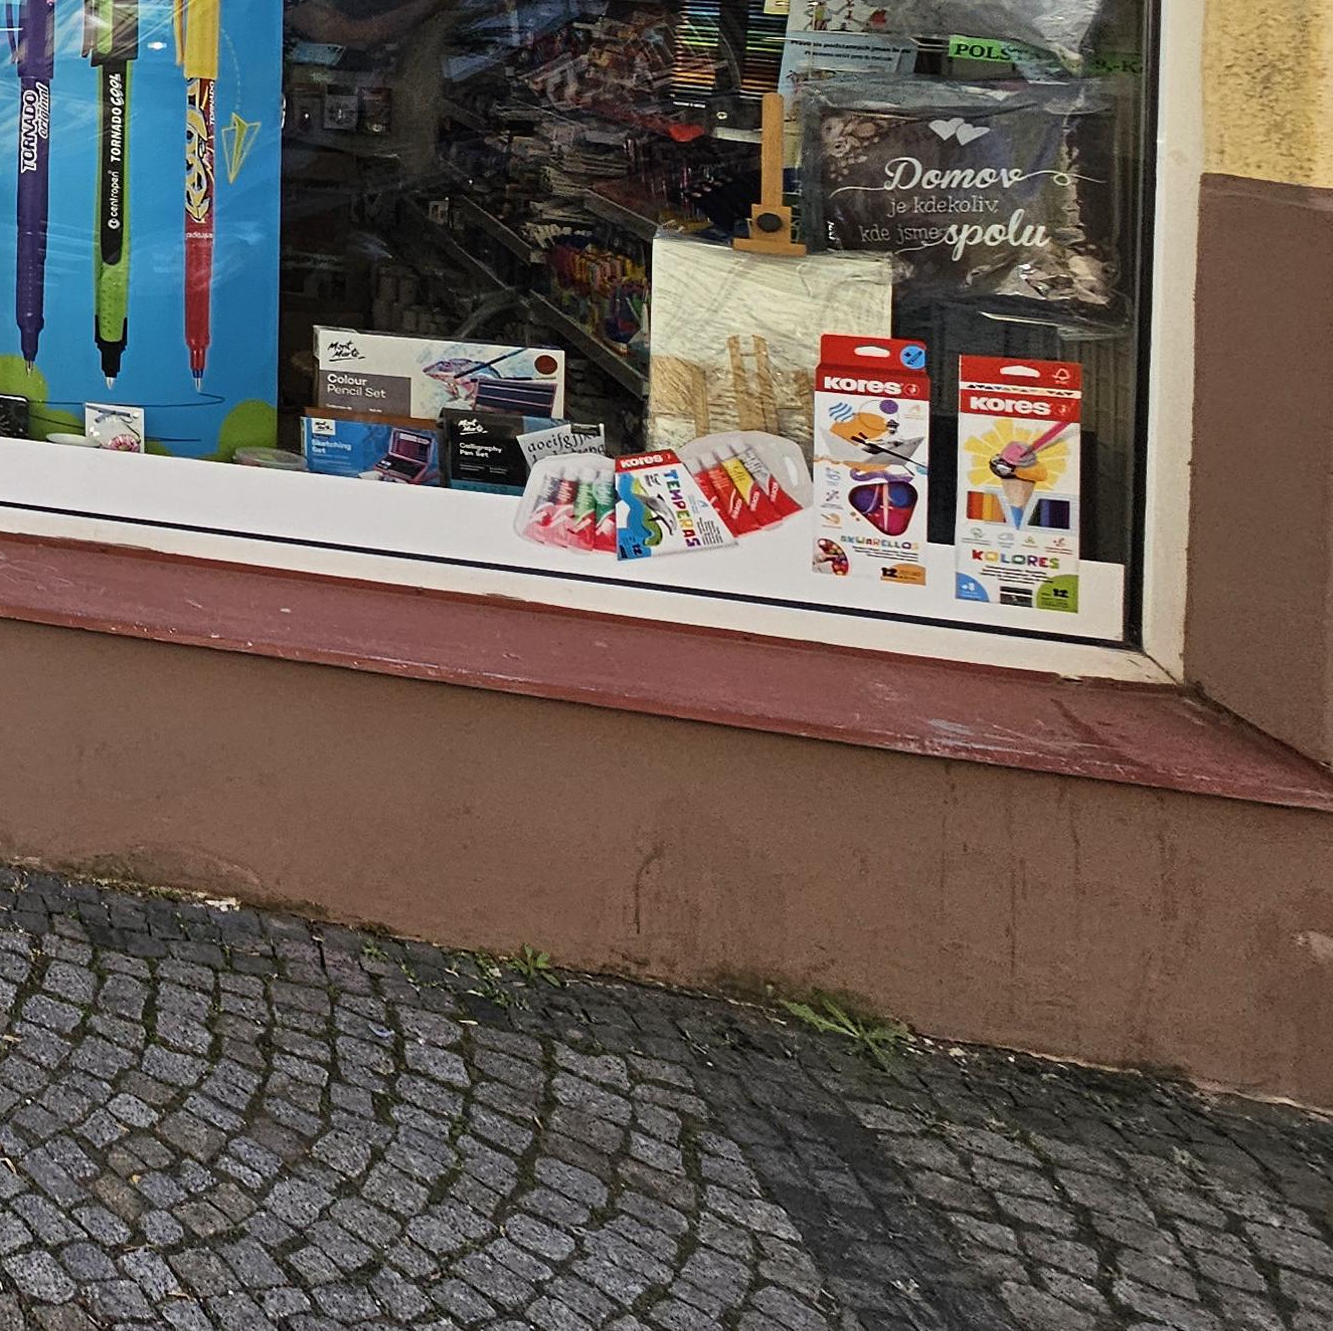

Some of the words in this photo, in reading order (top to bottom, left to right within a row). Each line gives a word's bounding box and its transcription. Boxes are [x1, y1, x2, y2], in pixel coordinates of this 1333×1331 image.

[35, 81, 50, 140] original
[20, 89, 39, 175] TORNADO
[110, 106, 123, 163] TORNADO
[882, 156, 1025, 191] Domov
[108, 170, 120, 218] centropen
[887, 199, 907, 218] je
[859, 225, 891, 242] kde
[896, 224, 941, 245] jsme
[941, 208, 1051, 262] spolu
[327, 373, 368, 387] Colour
[327, 384, 363, 397] Pencil
[364, 387, 387, 400] Set
[459, 441, 503, 454] Calligraphy
[663, 469, 702, 547] TEMPERAS
[881, 567, 898, 579] 12
[971, 549, 1061, 570] KOLORES
